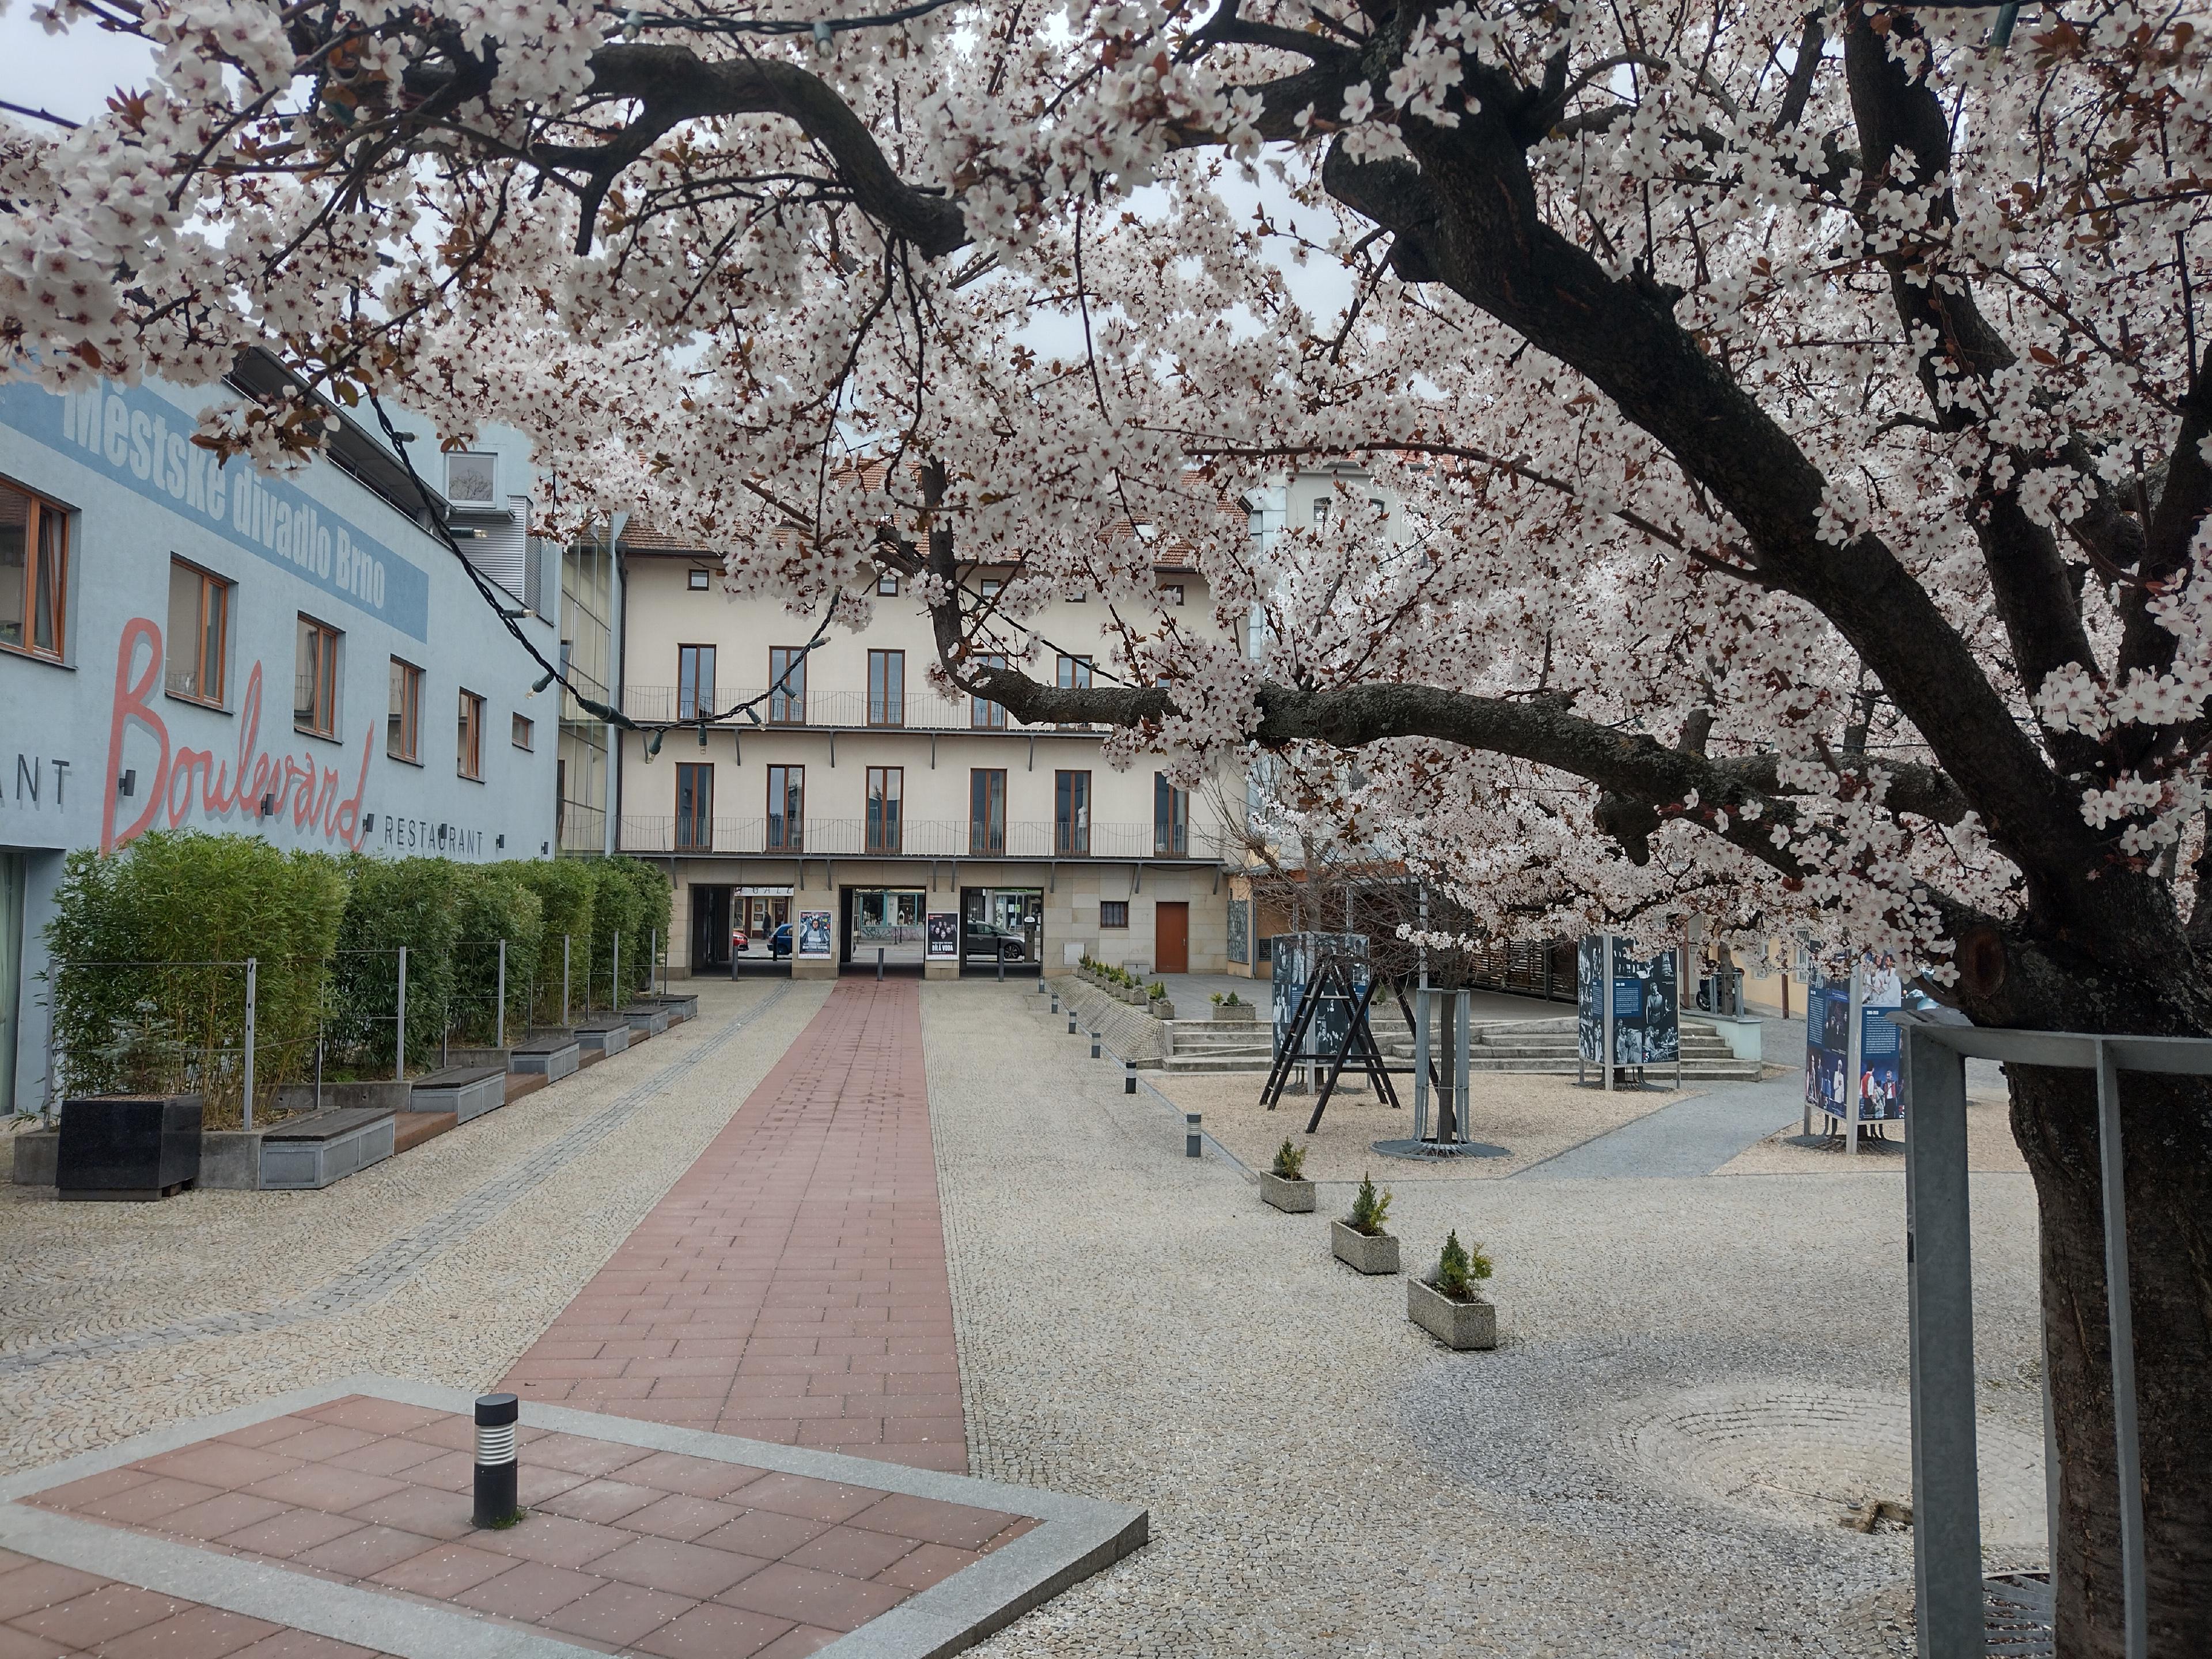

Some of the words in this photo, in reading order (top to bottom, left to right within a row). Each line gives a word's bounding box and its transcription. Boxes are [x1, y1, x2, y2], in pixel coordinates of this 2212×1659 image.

[233, 465, 331, 580] divadlo
[335, 525, 385, 609] Brno
[0, 753, 70, 805] NT
[100, 616, 375, 858] Boulevard
[384, 815, 483, 855] RESTAURANT
